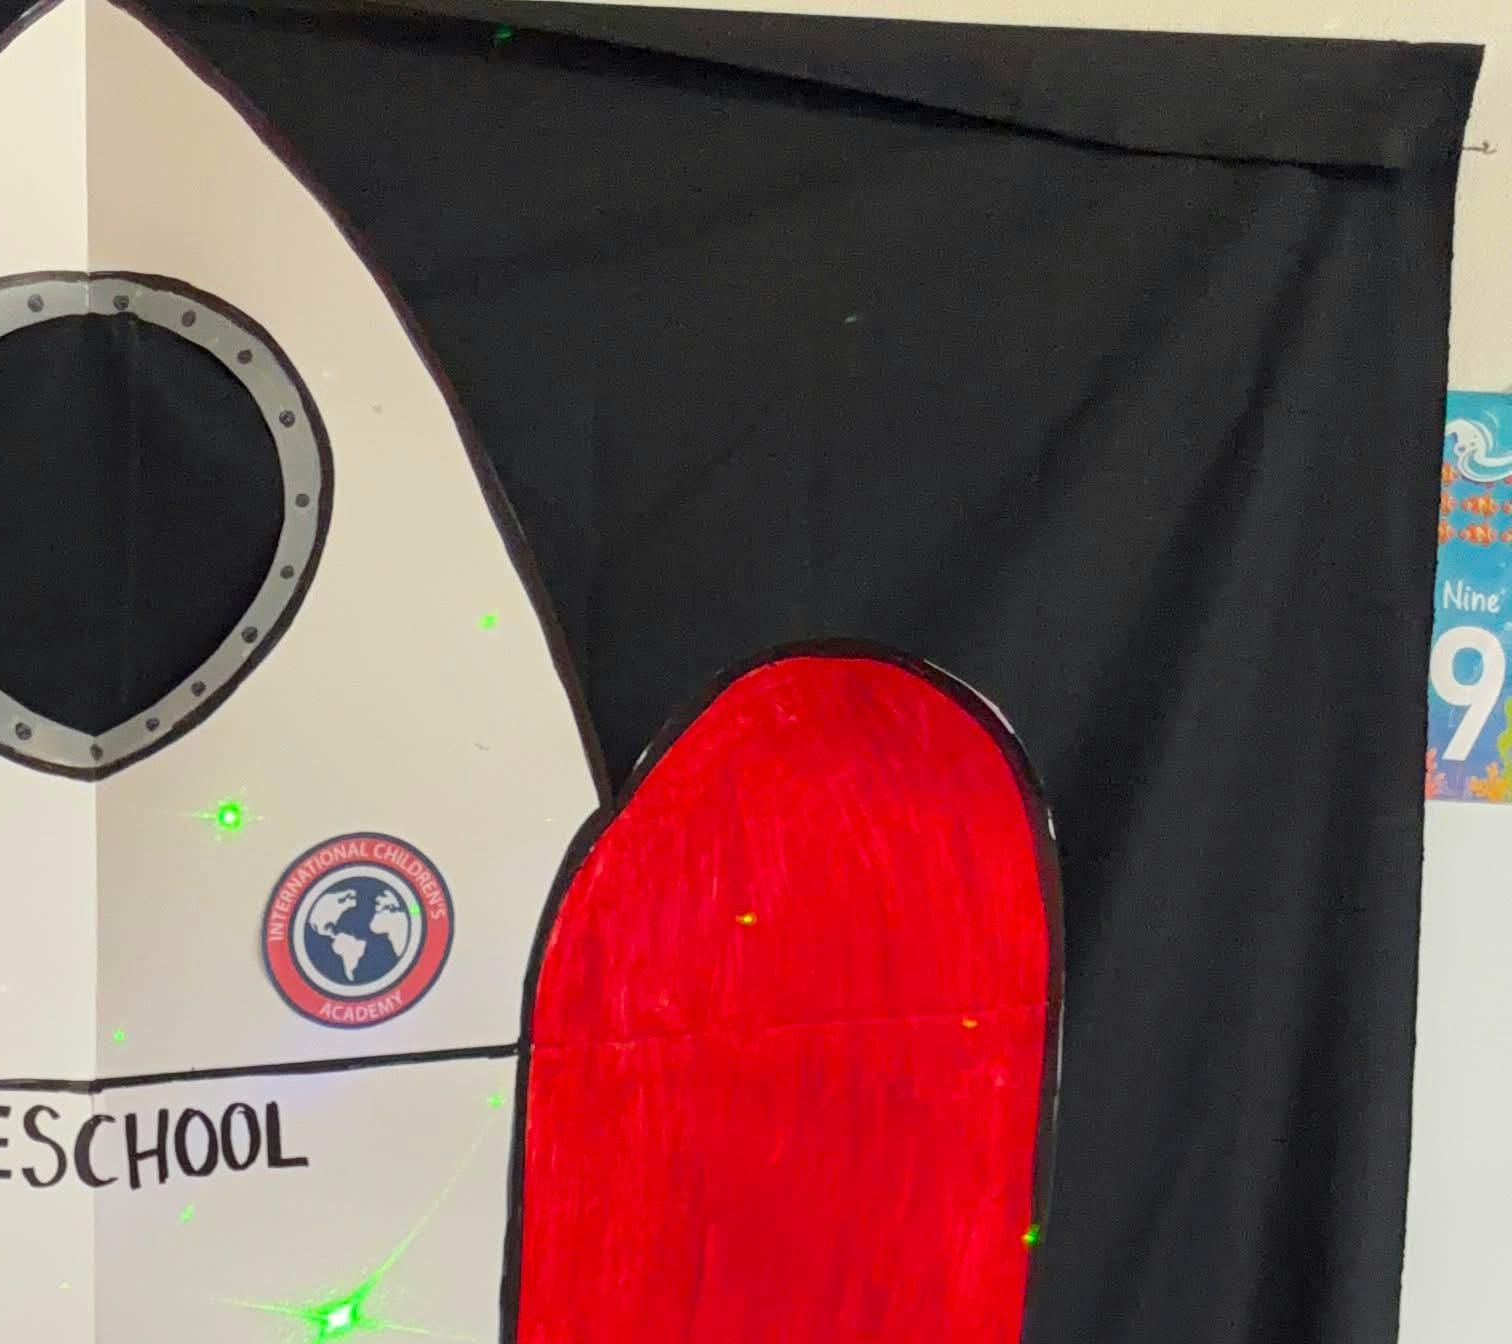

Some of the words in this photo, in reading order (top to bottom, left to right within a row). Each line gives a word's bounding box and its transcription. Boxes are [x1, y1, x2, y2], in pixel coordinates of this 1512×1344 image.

[1442, 579, 1502, 614] Nine
[1429, 625, 1506, 762] 9
[269, 841, 370, 941] INTERNATIONAL
[372, 842, 448, 920] CHILDREN'S
[319, 991, 402, 1022] ACADEMY
